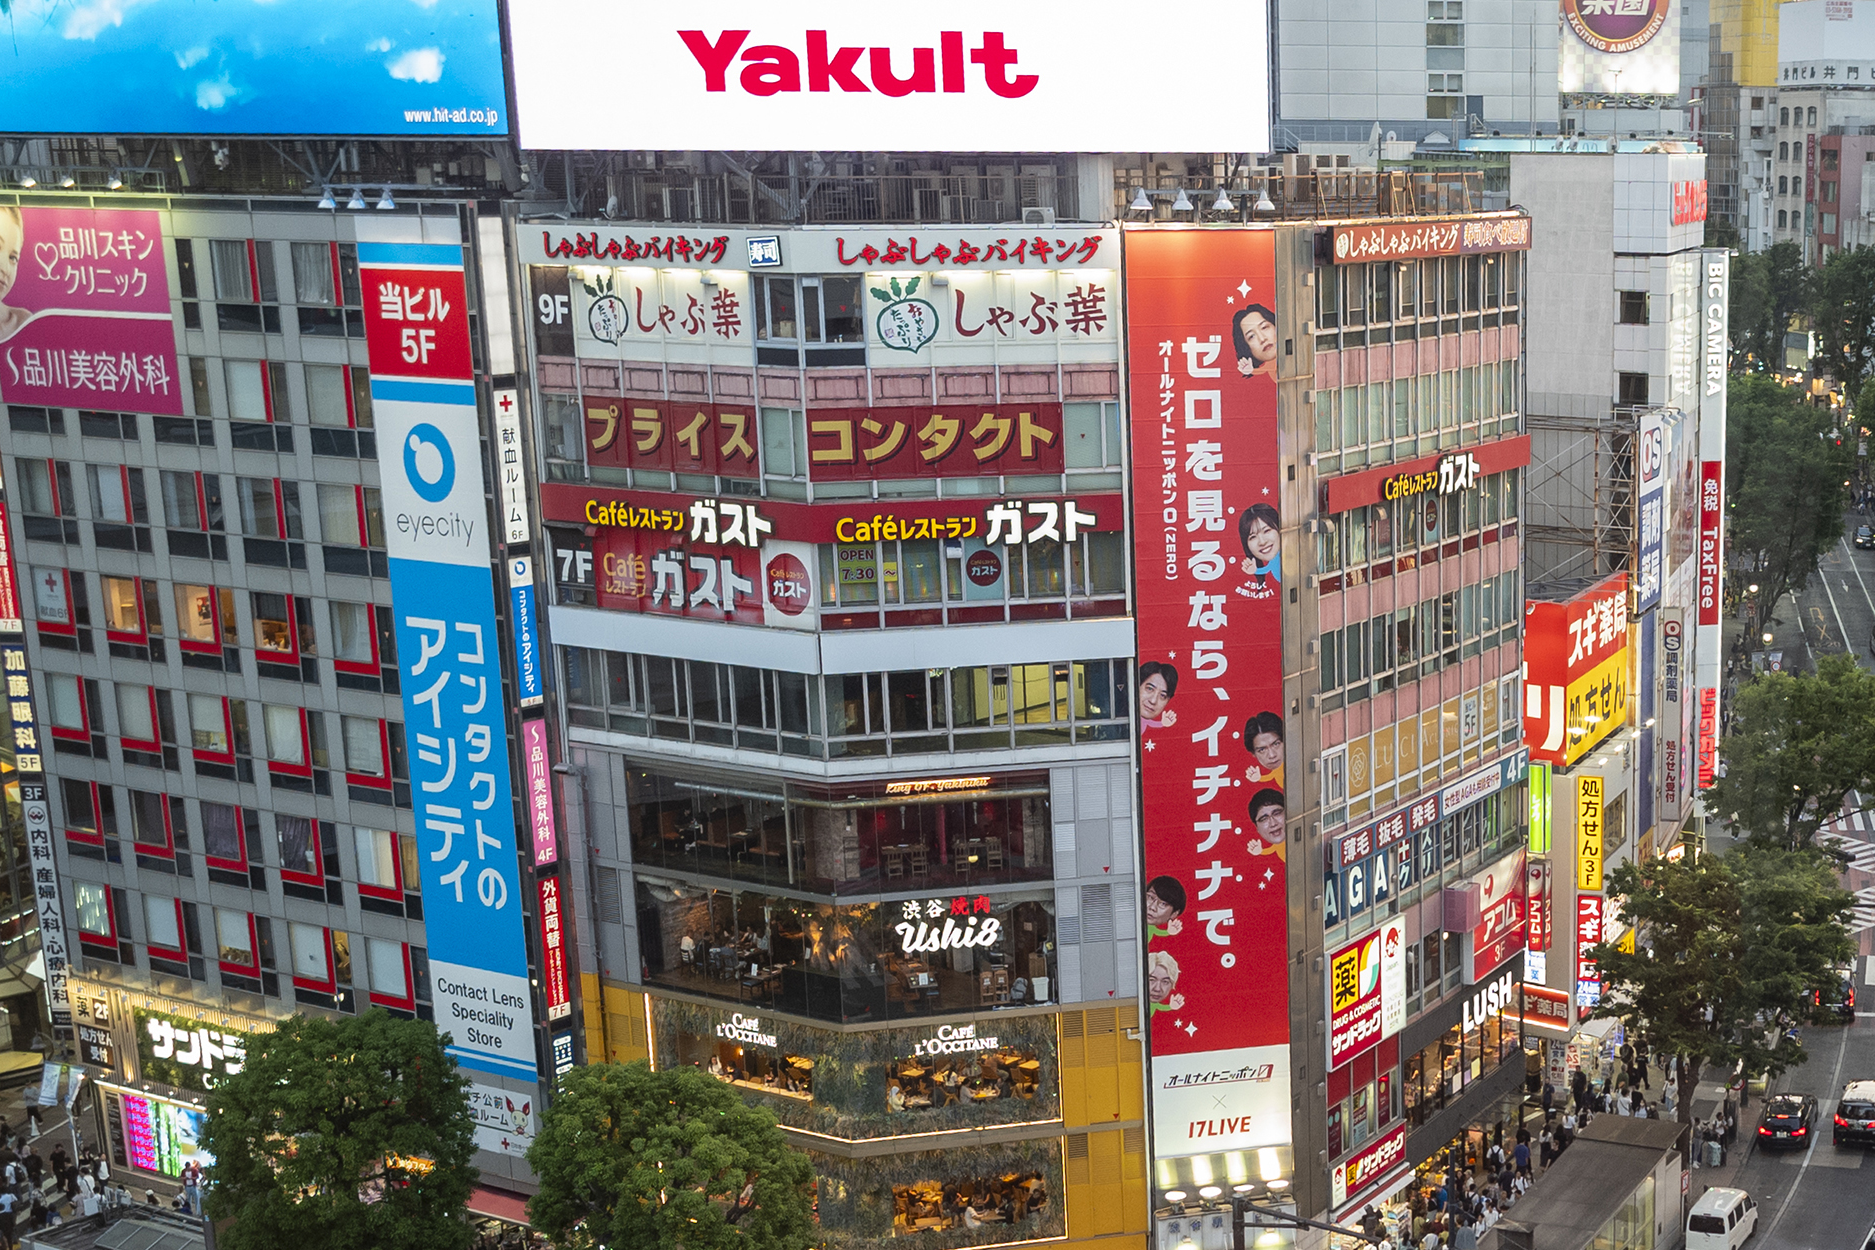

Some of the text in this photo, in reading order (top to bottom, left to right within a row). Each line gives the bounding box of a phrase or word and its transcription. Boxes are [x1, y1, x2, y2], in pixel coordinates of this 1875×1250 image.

[1567, 12, 1665, 53] EXCITING AMUSEMENT
[677, 29, 1040, 99] Yakult
[1783, 66, 1816, 82] 井門ビル
[404, 107, 498, 126] www.hit-ad.co.jp
[59, 227, 154, 261] 品川スキン
[542, 231, 730, 264] しゃぶしゃぶバイキング
[748, 240, 782, 263] 寿司
[836, 235, 1103, 266] しゃぶしゃぶバイキング
[1349, 223, 1460, 258] しゃぶしゃぶバイキング
[64, 265, 147, 298] クリニック
[378, 280, 450, 328] 当ビル
[538, 293, 569, 325] 9F
[636, 286, 742, 340] しゃぶ葉
[954, 283, 1108, 338] しゃぶ葉
[1706, 261, 1724, 397] BIC CAMERA
[400, 328, 437, 366] 5F
[24, 347, 171, 396] 品川美容外科
[586, 404, 758, 465] プライス
[812, 409, 1059, 465] コンタクト
[1641, 428, 1663, 480] OS
[501, 426, 522, 524] 献血ルーム
[1385, 452, 1481, 501] Caféレストラン ガスト
[396, 509, 474, 550] eyecity
[511, 529, 524, 541] 6F
[585, 499, 773, 548] Caféレストラン ガスト
[835, 500, 1097, 547] Caféレストラン ガスト
[1640, 495, 1661, 550] 調剤
[840, 549, 874, 561] OPEN
[1700, 478, 1719, 610] 免税 TaxFree
[556, 548, 593, 583] 7F
[603, 552, 646, 580] Café
[651, 550, 754, 613] ガスト
[841, 567, 875, 581] 7:30
[971, 565, 998, 577] ガスト
[605, 579, 647, 599] レストラン
[773, 579, 807, 599] ガスト
[2, 620, 18, 631] 7F
[518, 589, 536, 694] コンタクトのアイシティ
[1568, 589, 1627, 668] スギ薬局
[1664, 619, 1682, 651] OS
[1181, 334, 1236, 970] ゼロを見るなら、イチナナで。
[4, 649, 37, 750] 加藤眼科
[1568, 666, 1626, 751] 処方せん
[1463, 713, 1477, 738] 5F
[19, 756, 39, 770] 5F
[405, 615, 467, 908] アイシティ
[454, 619, 509, 912] コンタクトの
[1506, 751, 1527, 783] 4F
[1665, 738, 1677, 804] 処方せん受付
[24, 787, 43, 800] 3F
[530, 745, 551, 843] 品川美容外科
[1343, 831, 1371, 865] 薄毛
[1377, 813, 1405, 847] 抜毛
[1411, 798, 1437, 831] 発毛
[1581, 779, 1600, 857] 処方せん
[30, 829, 51, 861] 内科
[537, 847, 553, 862] 4F
[1323, 853, 1389, 922] AGA
[1584, 860, 1595, 886] 3F
[542, 880, 561, 950] 外貨両替
[902, 895, 991, 920] 渋谷 焼肉
[1482, 898, 1517, 943] アコム
[1529, 900, 1542, 935] アコム
[894, 917, 1001, 954] Ushi8
[1494, 940, 1506, 962] 3F
[436, 977, 525, 1009] Contact Lens
[1335, 955, 1356, 1008] 薬
[77, 995, 109, 1021] 薬 2F
[451, 1002, 515, 1031] Speciality
[552, 1005, 567, 1018] 7F
[1332, 994, 1382, 1032] DRUG COSMETIC
[1462, 970, 1513, 1035] LUSH
[79, 1024, 114, 1047] 処方せん
[466, 1026, 503, 1049] Store
[716, 1023, 778, 1049] L'OCCITANE
[731, 1012, 760, 1032] CAFÉ
[937, 1023, 976, 1041] CAFÉ
[1332, 1009, 1383, 1057] サンドラッグ
[90, 1044, 109, 1064] 受付
[914, 1035, 1000, 1057] L'OCCITANE
[1188, 1115, 1252, 1138] 17LIVE
[1363, 1131, 1405, 1174] サンドラッグ
